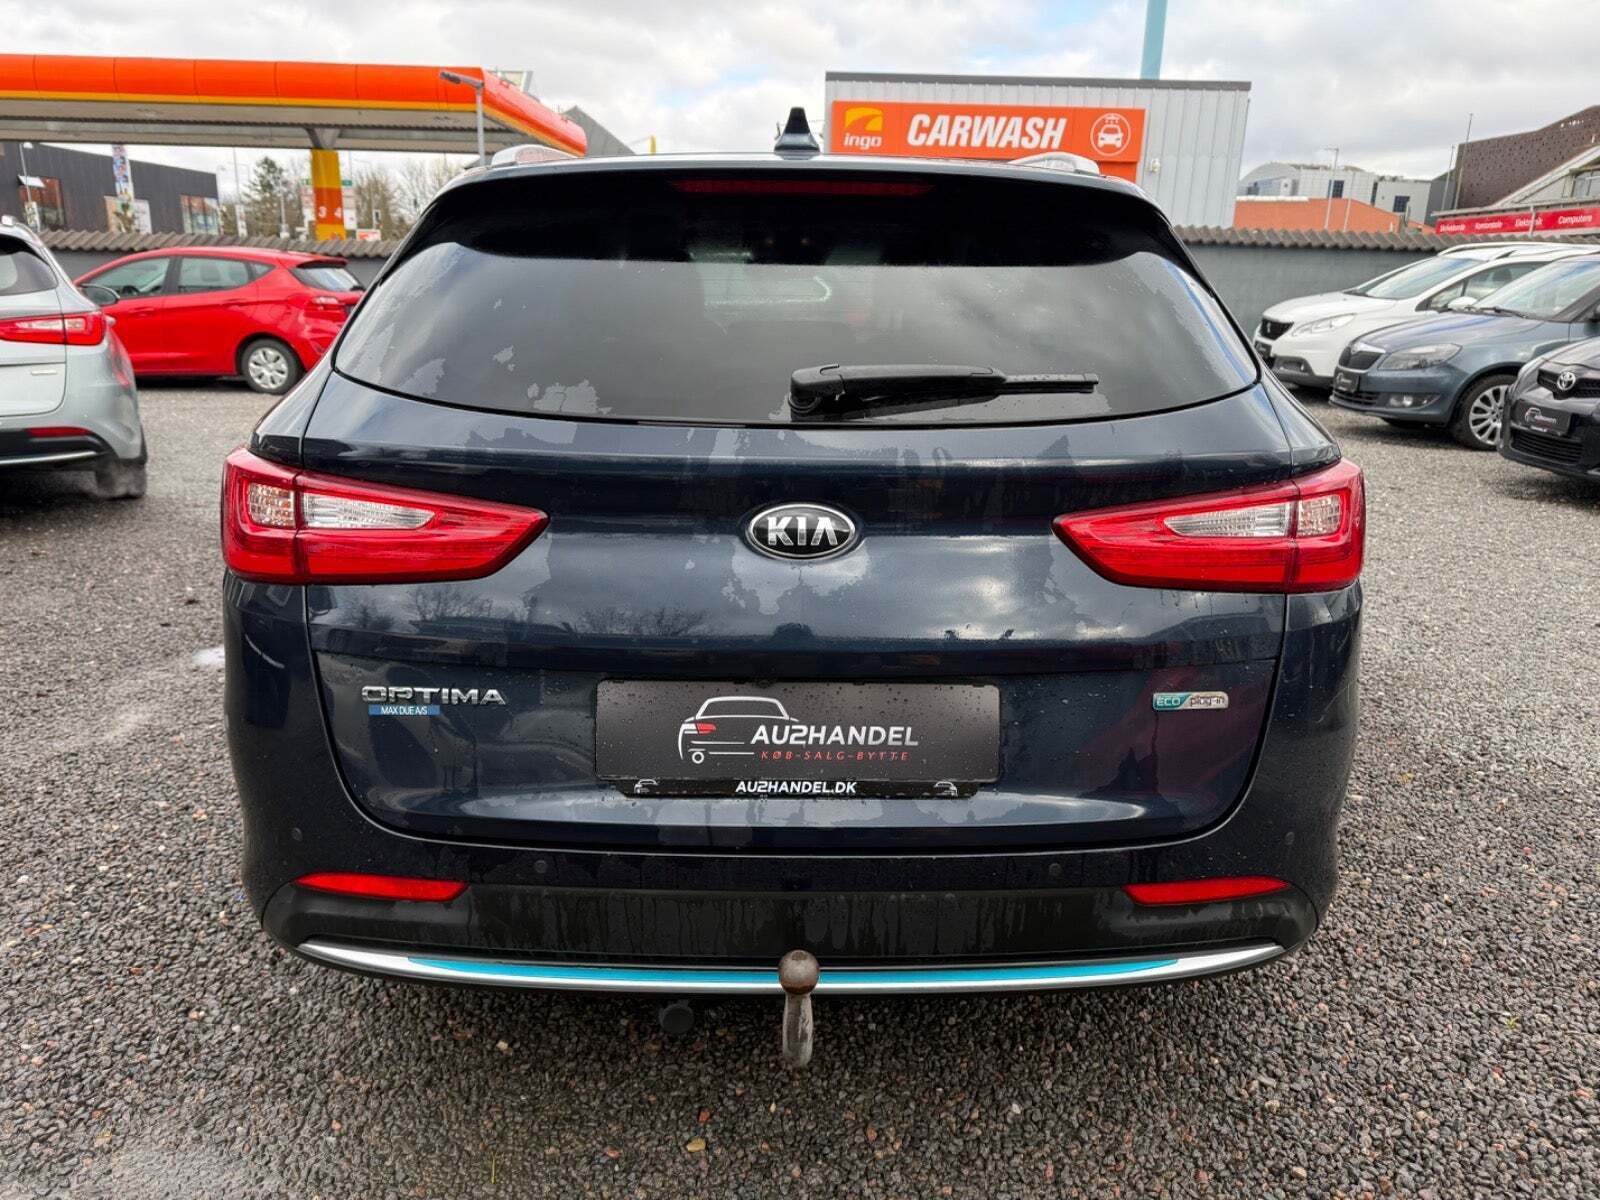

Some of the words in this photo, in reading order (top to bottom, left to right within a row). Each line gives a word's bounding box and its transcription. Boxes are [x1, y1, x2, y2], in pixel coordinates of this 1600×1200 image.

[907, 114, 1067, 149] CARWASH
[844, 132, 882, 150] ingo
[318, 206, 327, 219] 3
[766, 516, 838, 546] KIA
[361, 685, 506, 705] OPTIMA
[1156, 696, 1180, 706] ECO
[1190, 695, 1225, 707] plug-in
[381, 705, 399, 715] MAX
[400, 705, 415, 715] DUE
[415, 705, 428, 715] A/S
[751, 725, 919, 746] AU2HANDEL
[735, 780, 858, 794] AU2HANDEL.DK
